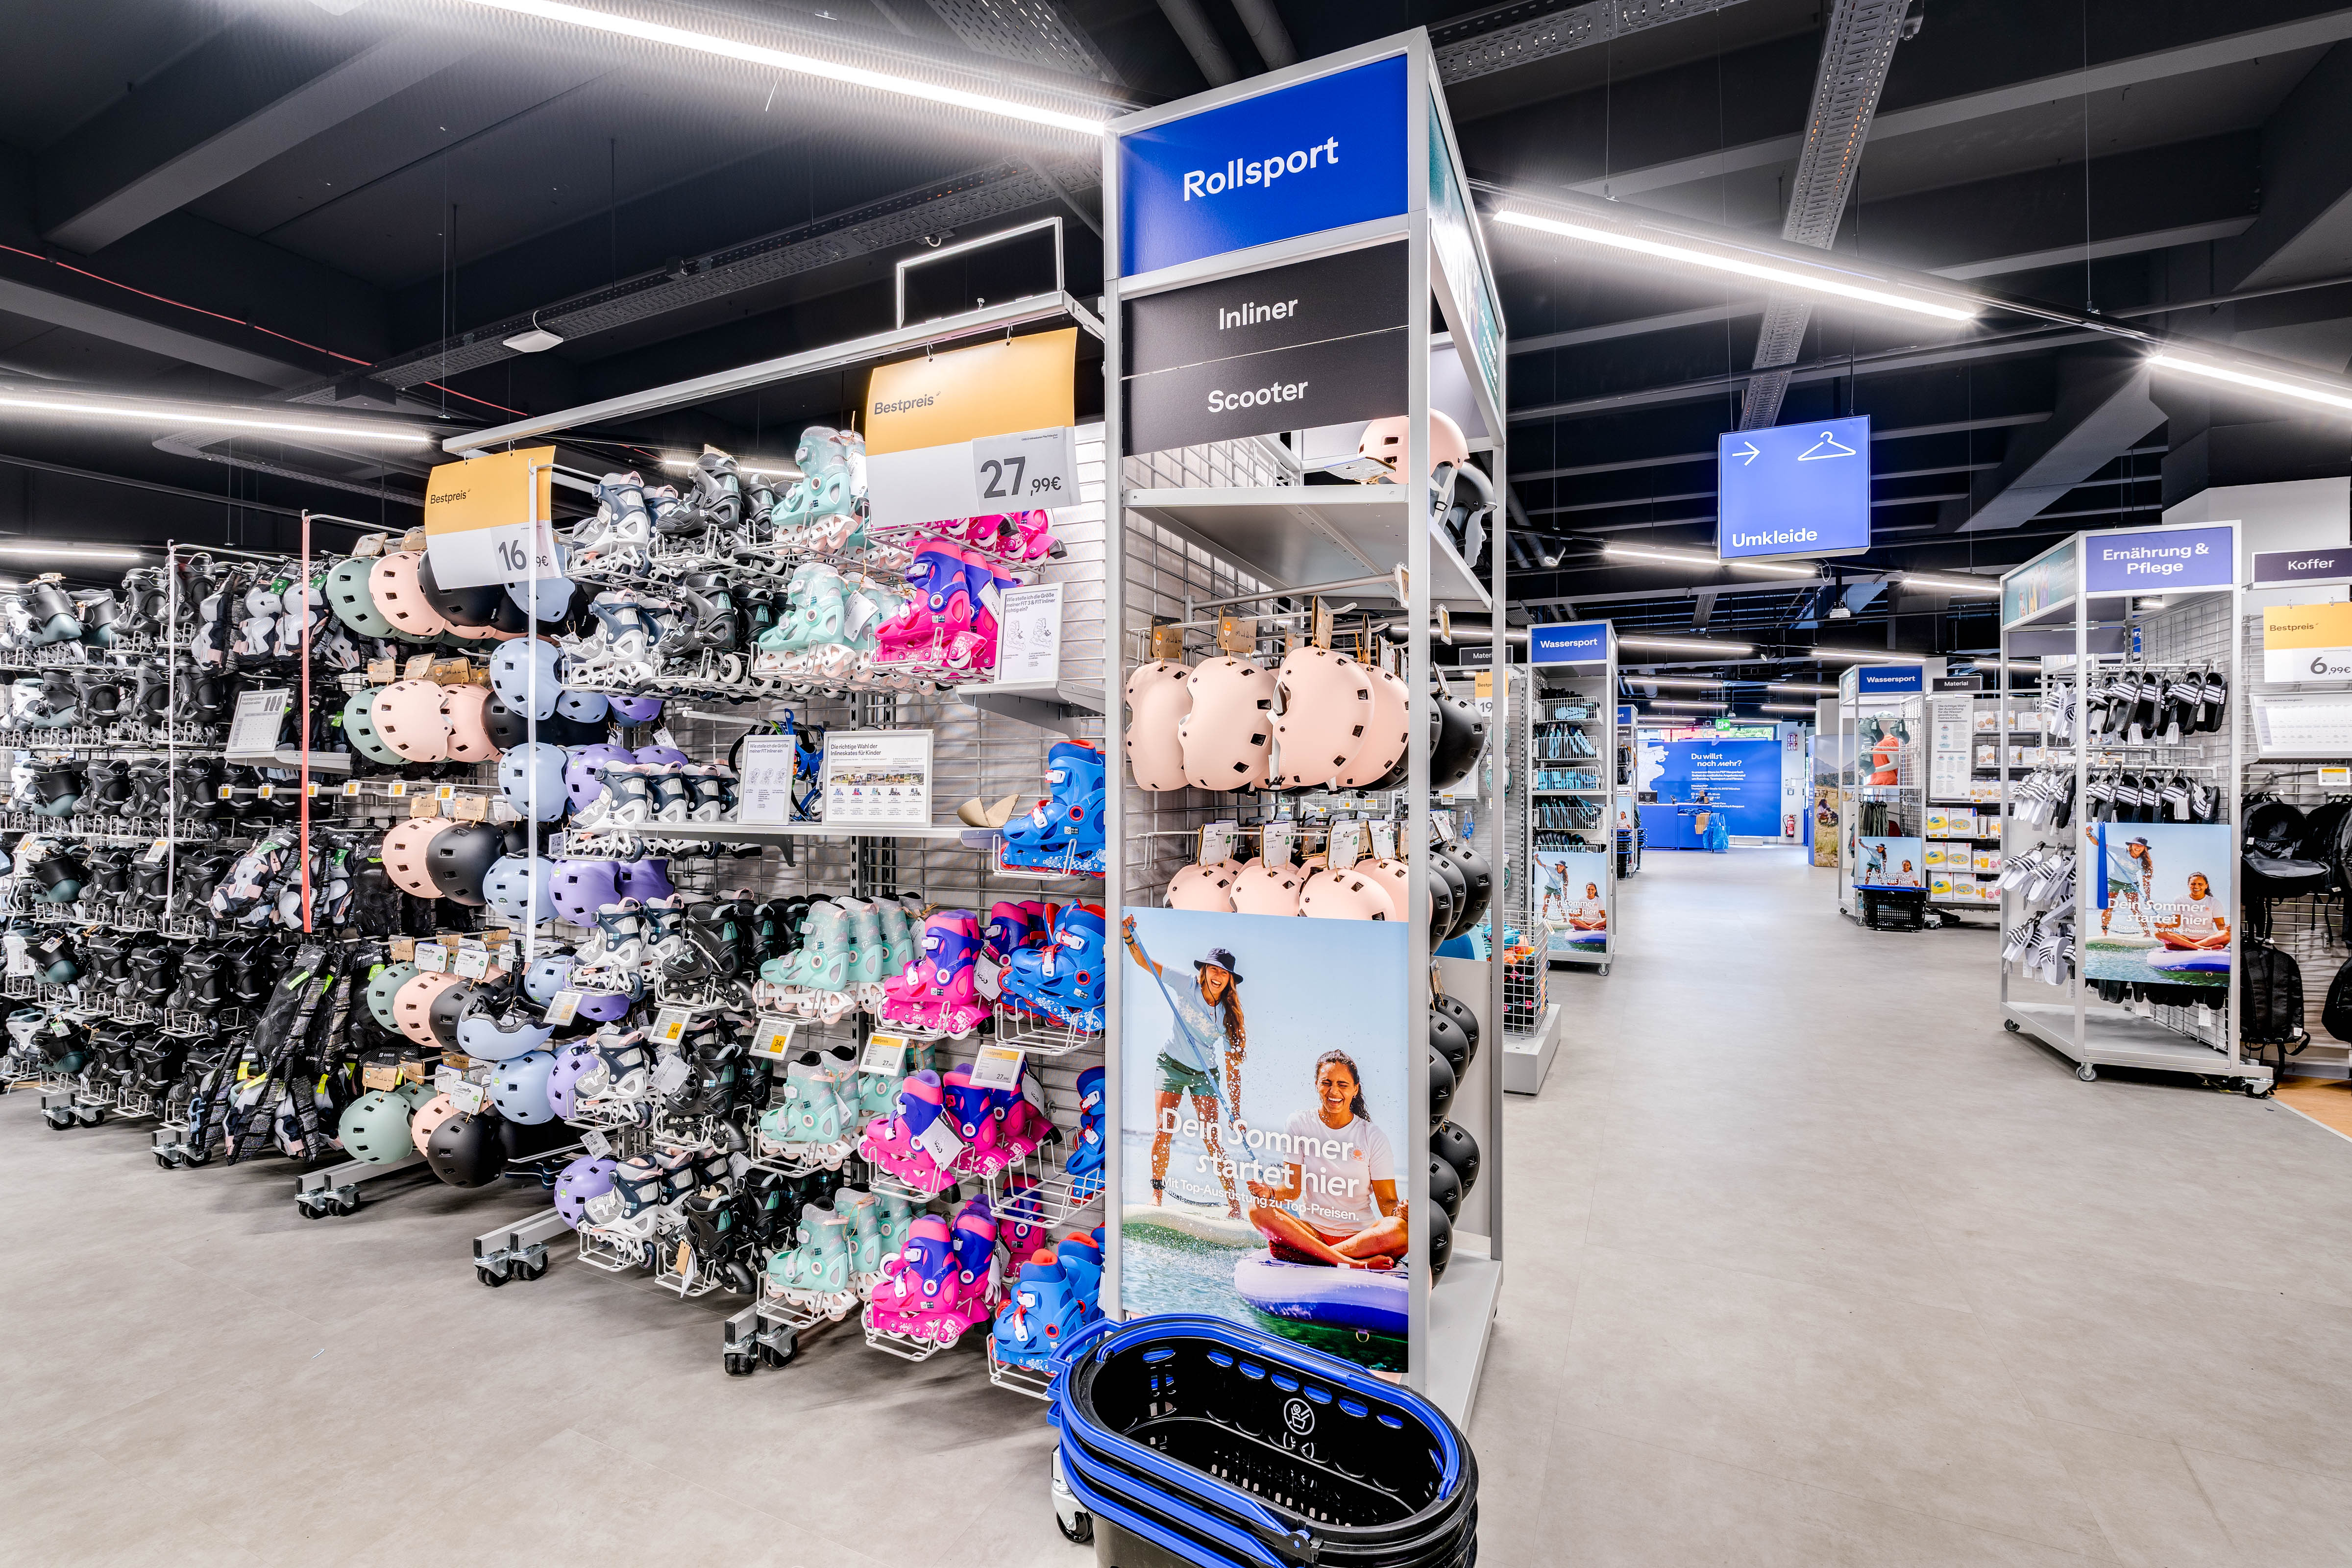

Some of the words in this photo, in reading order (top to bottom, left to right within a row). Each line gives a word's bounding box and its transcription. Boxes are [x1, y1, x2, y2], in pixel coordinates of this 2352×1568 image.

[1183, 136, 1339, 201] Rollsport
[1219, 299, 1298, 330] Inliner
[874, 393, 934, 415] Bestpreis
[1207, 381, 1308, 413] Scooter
[431, 490, 466, 505] Bestpreis
[1732, 528, 1818, 547] Umkleide
[2103, 545, 2192, 561] Ernährung
[2195, 542, 2209, 555] &
[2127, 562, 2183, 576] Pflege
[2288, 559, 2335, 570] Koffer
[1540, 638, 1597, 648] Wassersport
[2108, 898, 2142, 909] Dein
[2144, 899, 2206, 913] Sommer
[2126, 913, 2179, 925] startet
[2180, 914, 2208, 926] hier
[1162, 1107, 1223, 1142] Dein
[1227, 1118, 1354, 1162] Sommer
[1196, 1152, 1295, 1188] startet
[1301, 1163, 1360, 1198] hier
[1162, 1176, 1179, 1190] Mit
[1180, 1178, 1268, 1209] Top-Ausrüstung
[1269, 1196, 1282, 1209] zu
[1286, 1200, 1360, 1222] Top-Preisen.
